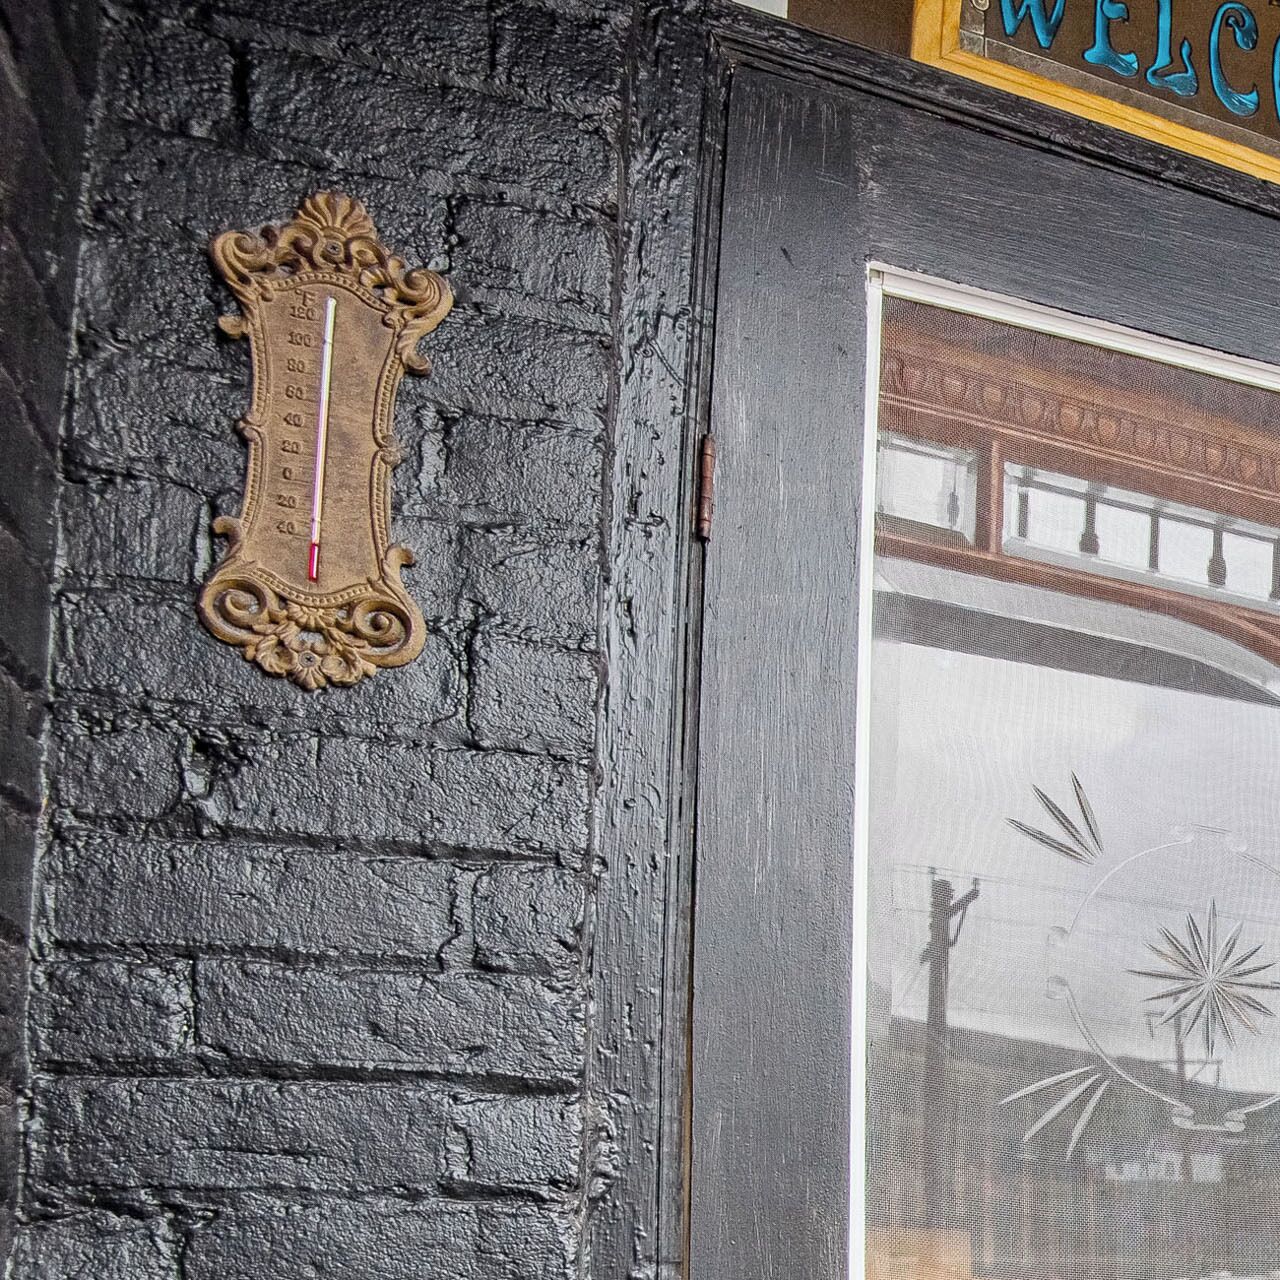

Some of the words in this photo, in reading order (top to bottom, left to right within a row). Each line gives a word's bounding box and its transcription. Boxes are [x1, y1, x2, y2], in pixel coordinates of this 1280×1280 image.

[289, 305, 317, 321] 120
[287, 331, 313, 348] 100
[286, 358, 306, 374] 80
[285, 384, 305, 401] 60
[283, 412, 304, 428] 40
[281, 440, 302, 455] 20
[282, 467, 294, 481] 0
[276, 494, 298, 509] 20
[276, 520, 296, 535] 40
